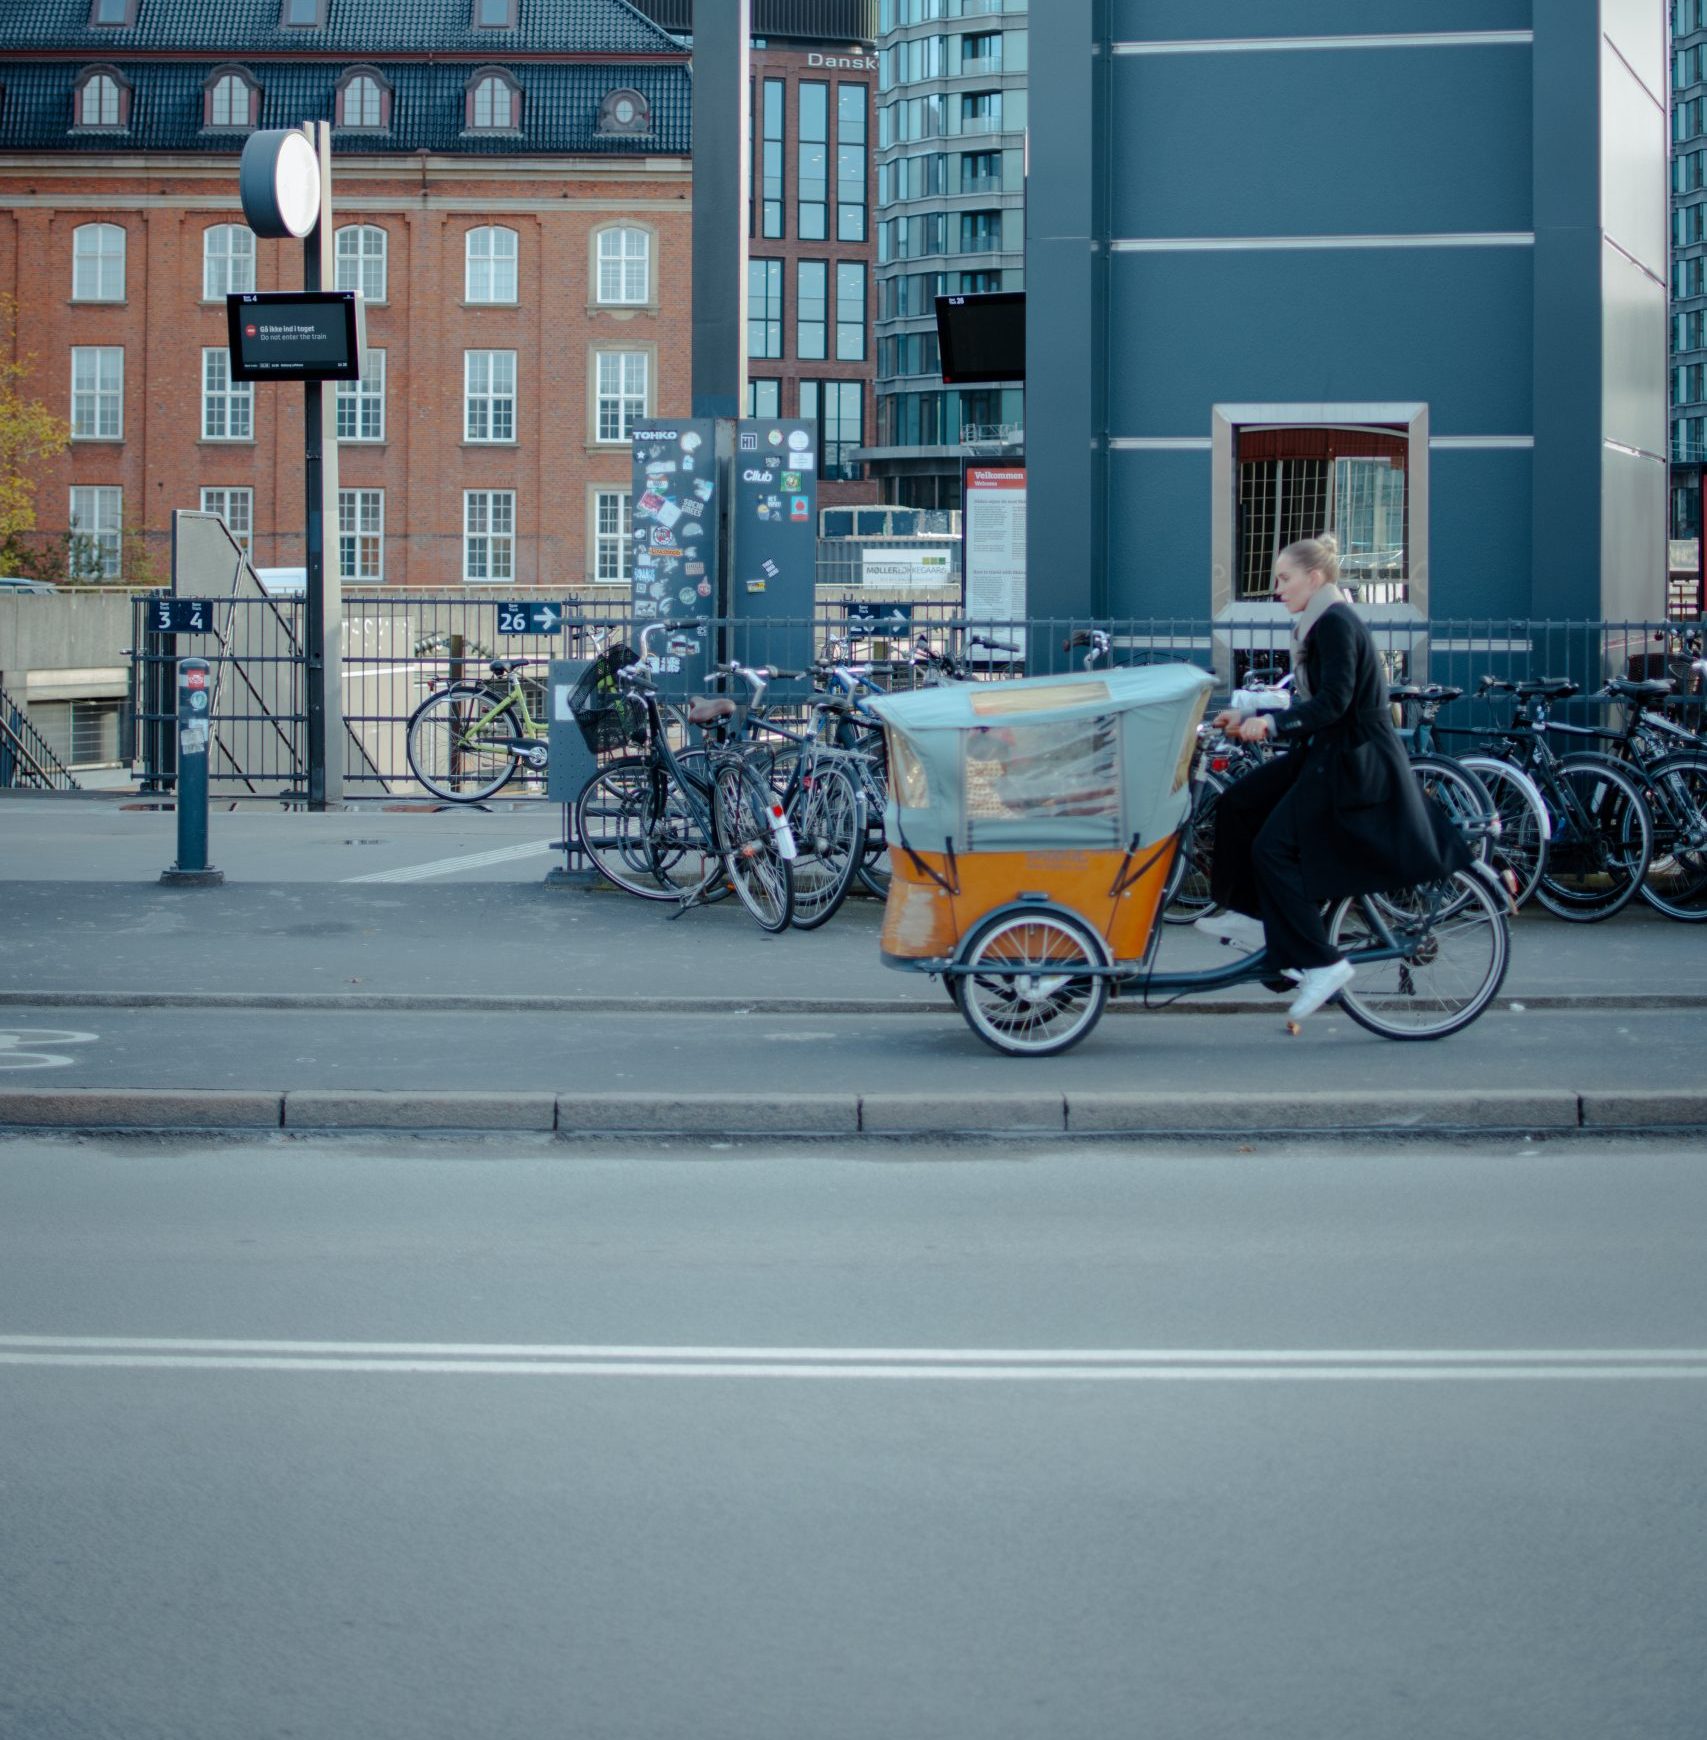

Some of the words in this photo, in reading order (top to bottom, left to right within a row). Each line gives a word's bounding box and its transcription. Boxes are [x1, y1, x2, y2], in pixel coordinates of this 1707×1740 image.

[808, 52, 880, 70] Dansk
[297, 325, 315, 334] toget
[975, 471, 1024, 480] Velkommen
[158, 611, 171, 629] 3
[190, 611, 203, 629] 4
[500, 613, 526, 631] 26
